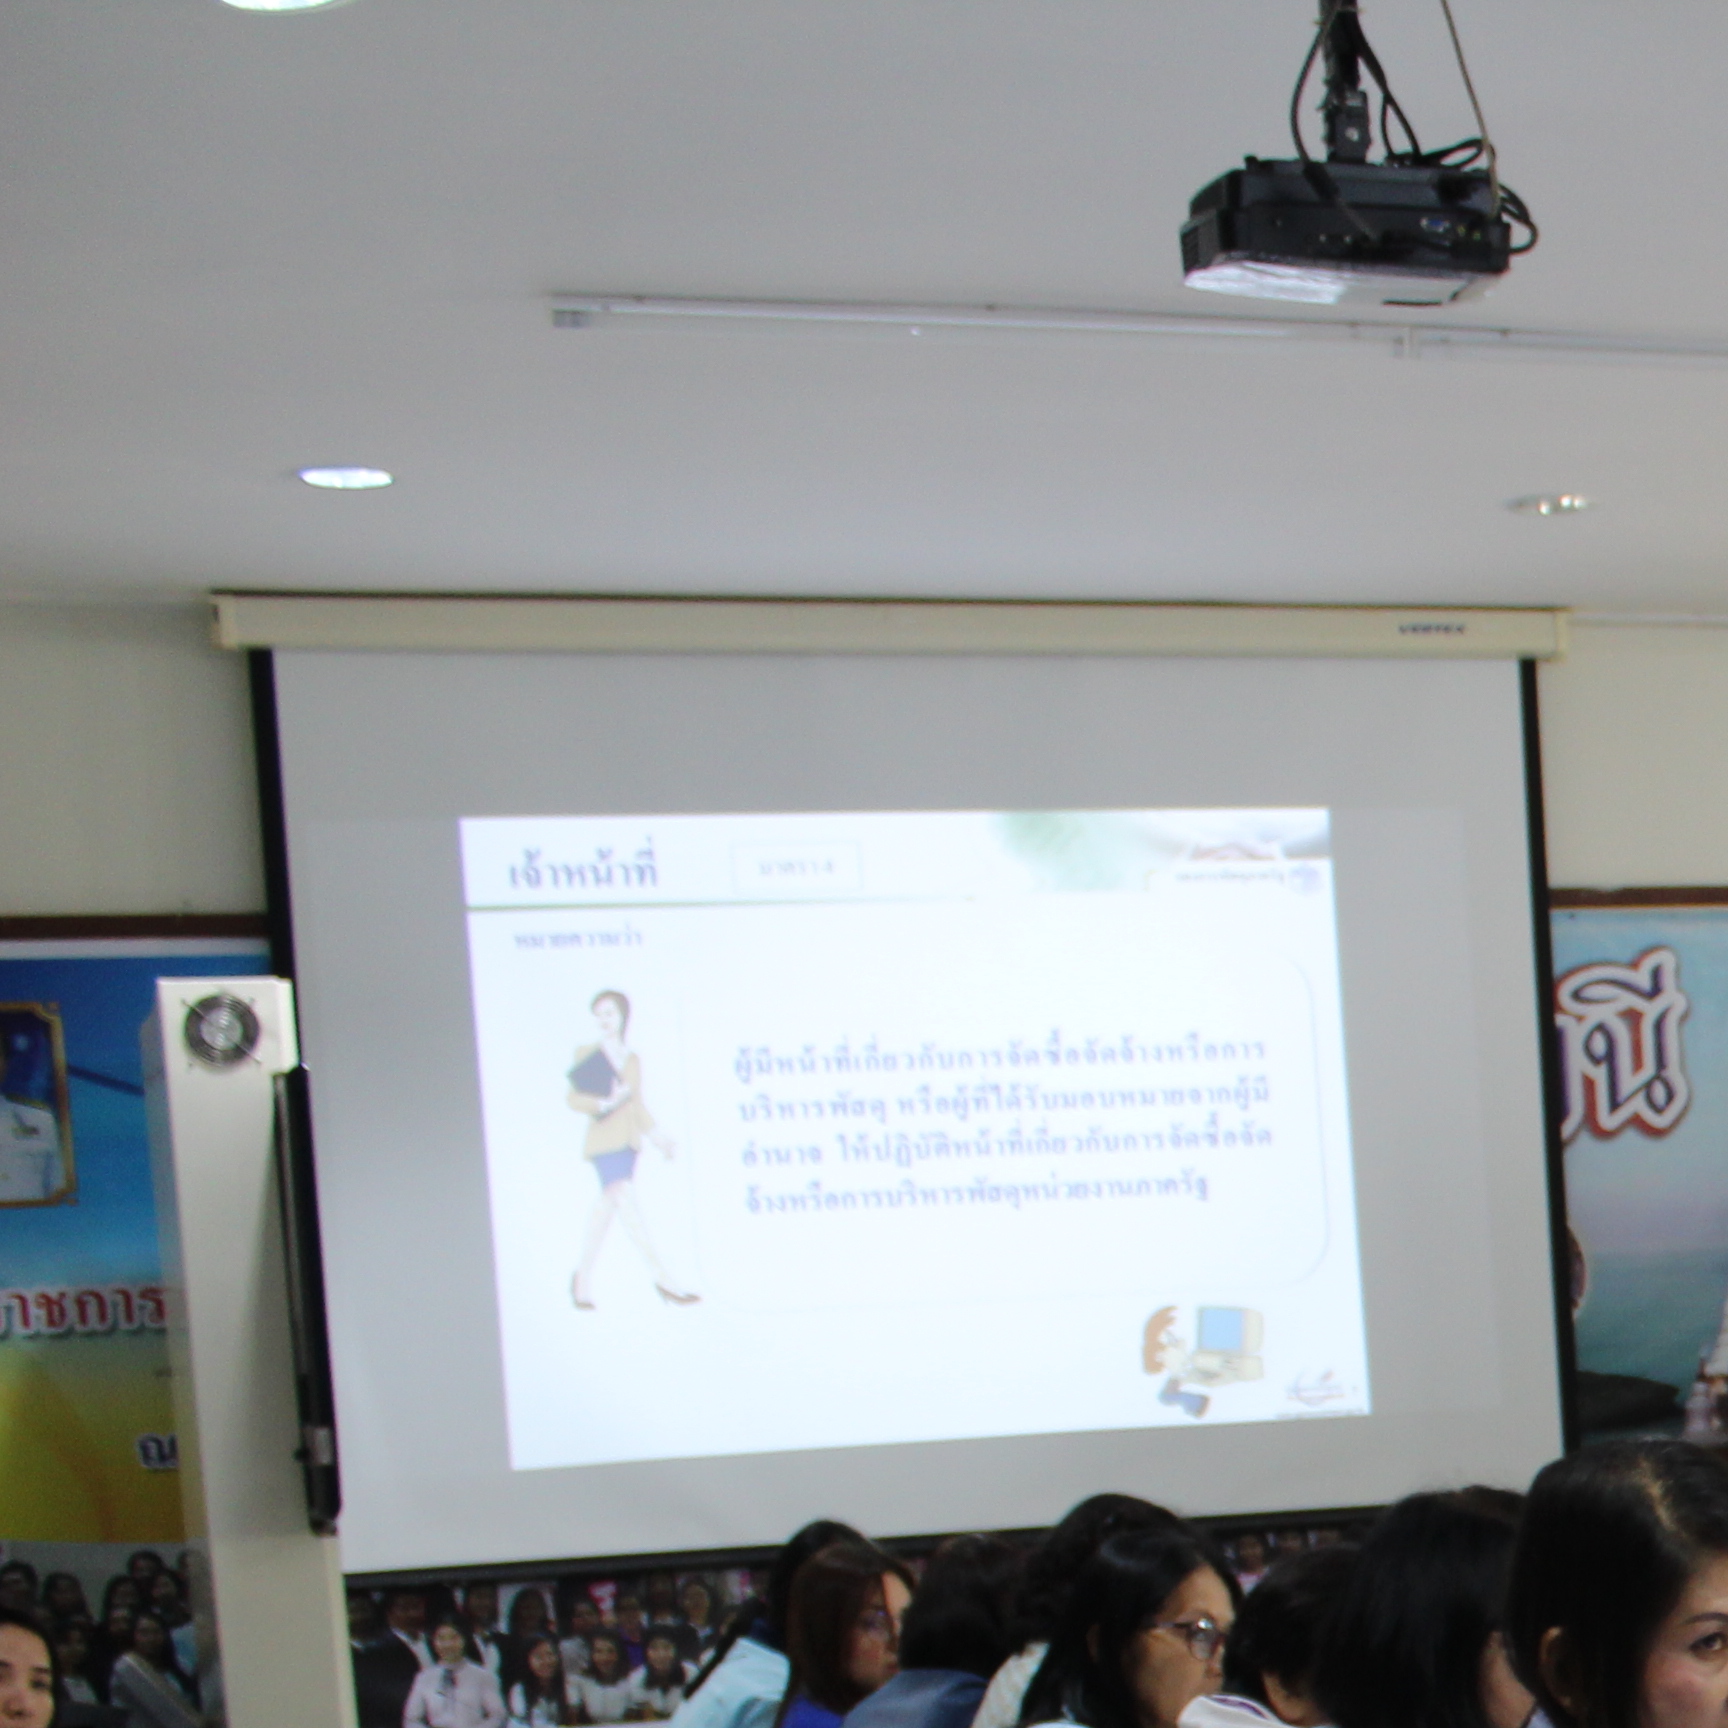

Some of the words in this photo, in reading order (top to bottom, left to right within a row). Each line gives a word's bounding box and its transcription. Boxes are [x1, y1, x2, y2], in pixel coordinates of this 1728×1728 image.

[509, 836, 660, 889] เจ้าหน้าที่
[0, 1286, 168, 1331] าชการ
